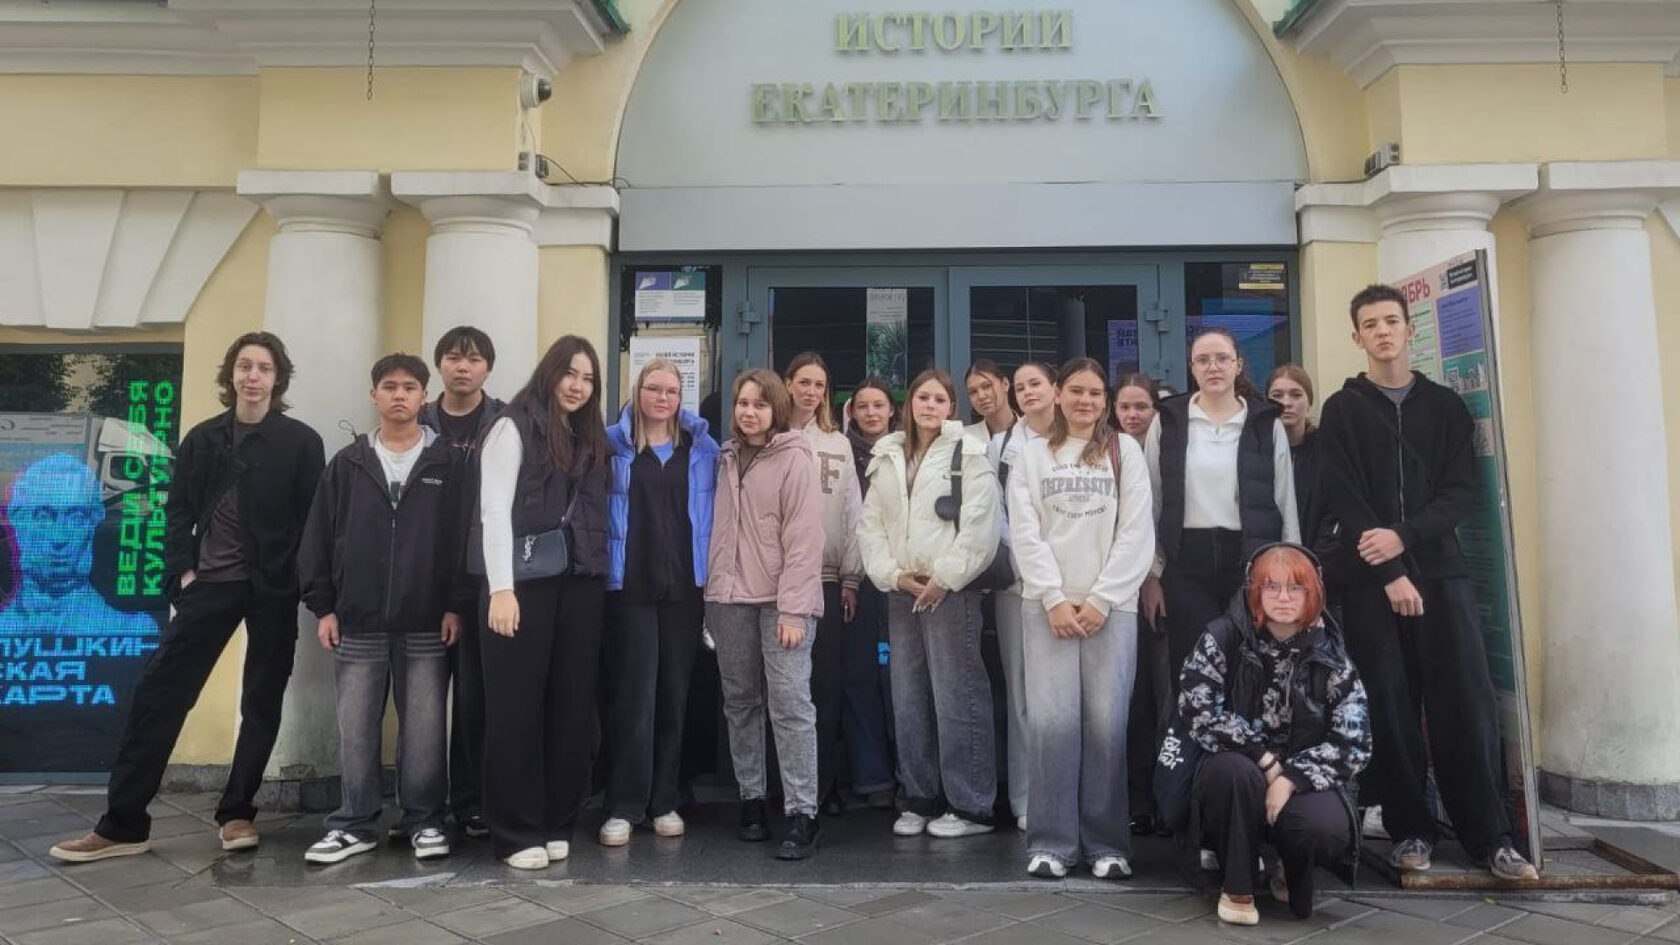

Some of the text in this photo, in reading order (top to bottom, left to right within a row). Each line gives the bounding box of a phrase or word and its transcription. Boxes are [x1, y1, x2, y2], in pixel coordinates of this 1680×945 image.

[834, 10, 1073, 52] ИСТОРИИ
[750, 77, 1167, 125] ЕКАТЕРИНБУРГА
[117, 380, 149, 596] ВЕДИ СЕБЯ
[143, 381, 175, 596] КУЛЬТУРНО
[817, 451, 846, 494] F
[1041, 476, 1118, 500] IMPRESSIV
[0, 661, 86, 680] КАЯ
[0, 685, 116, 704] АРТА
